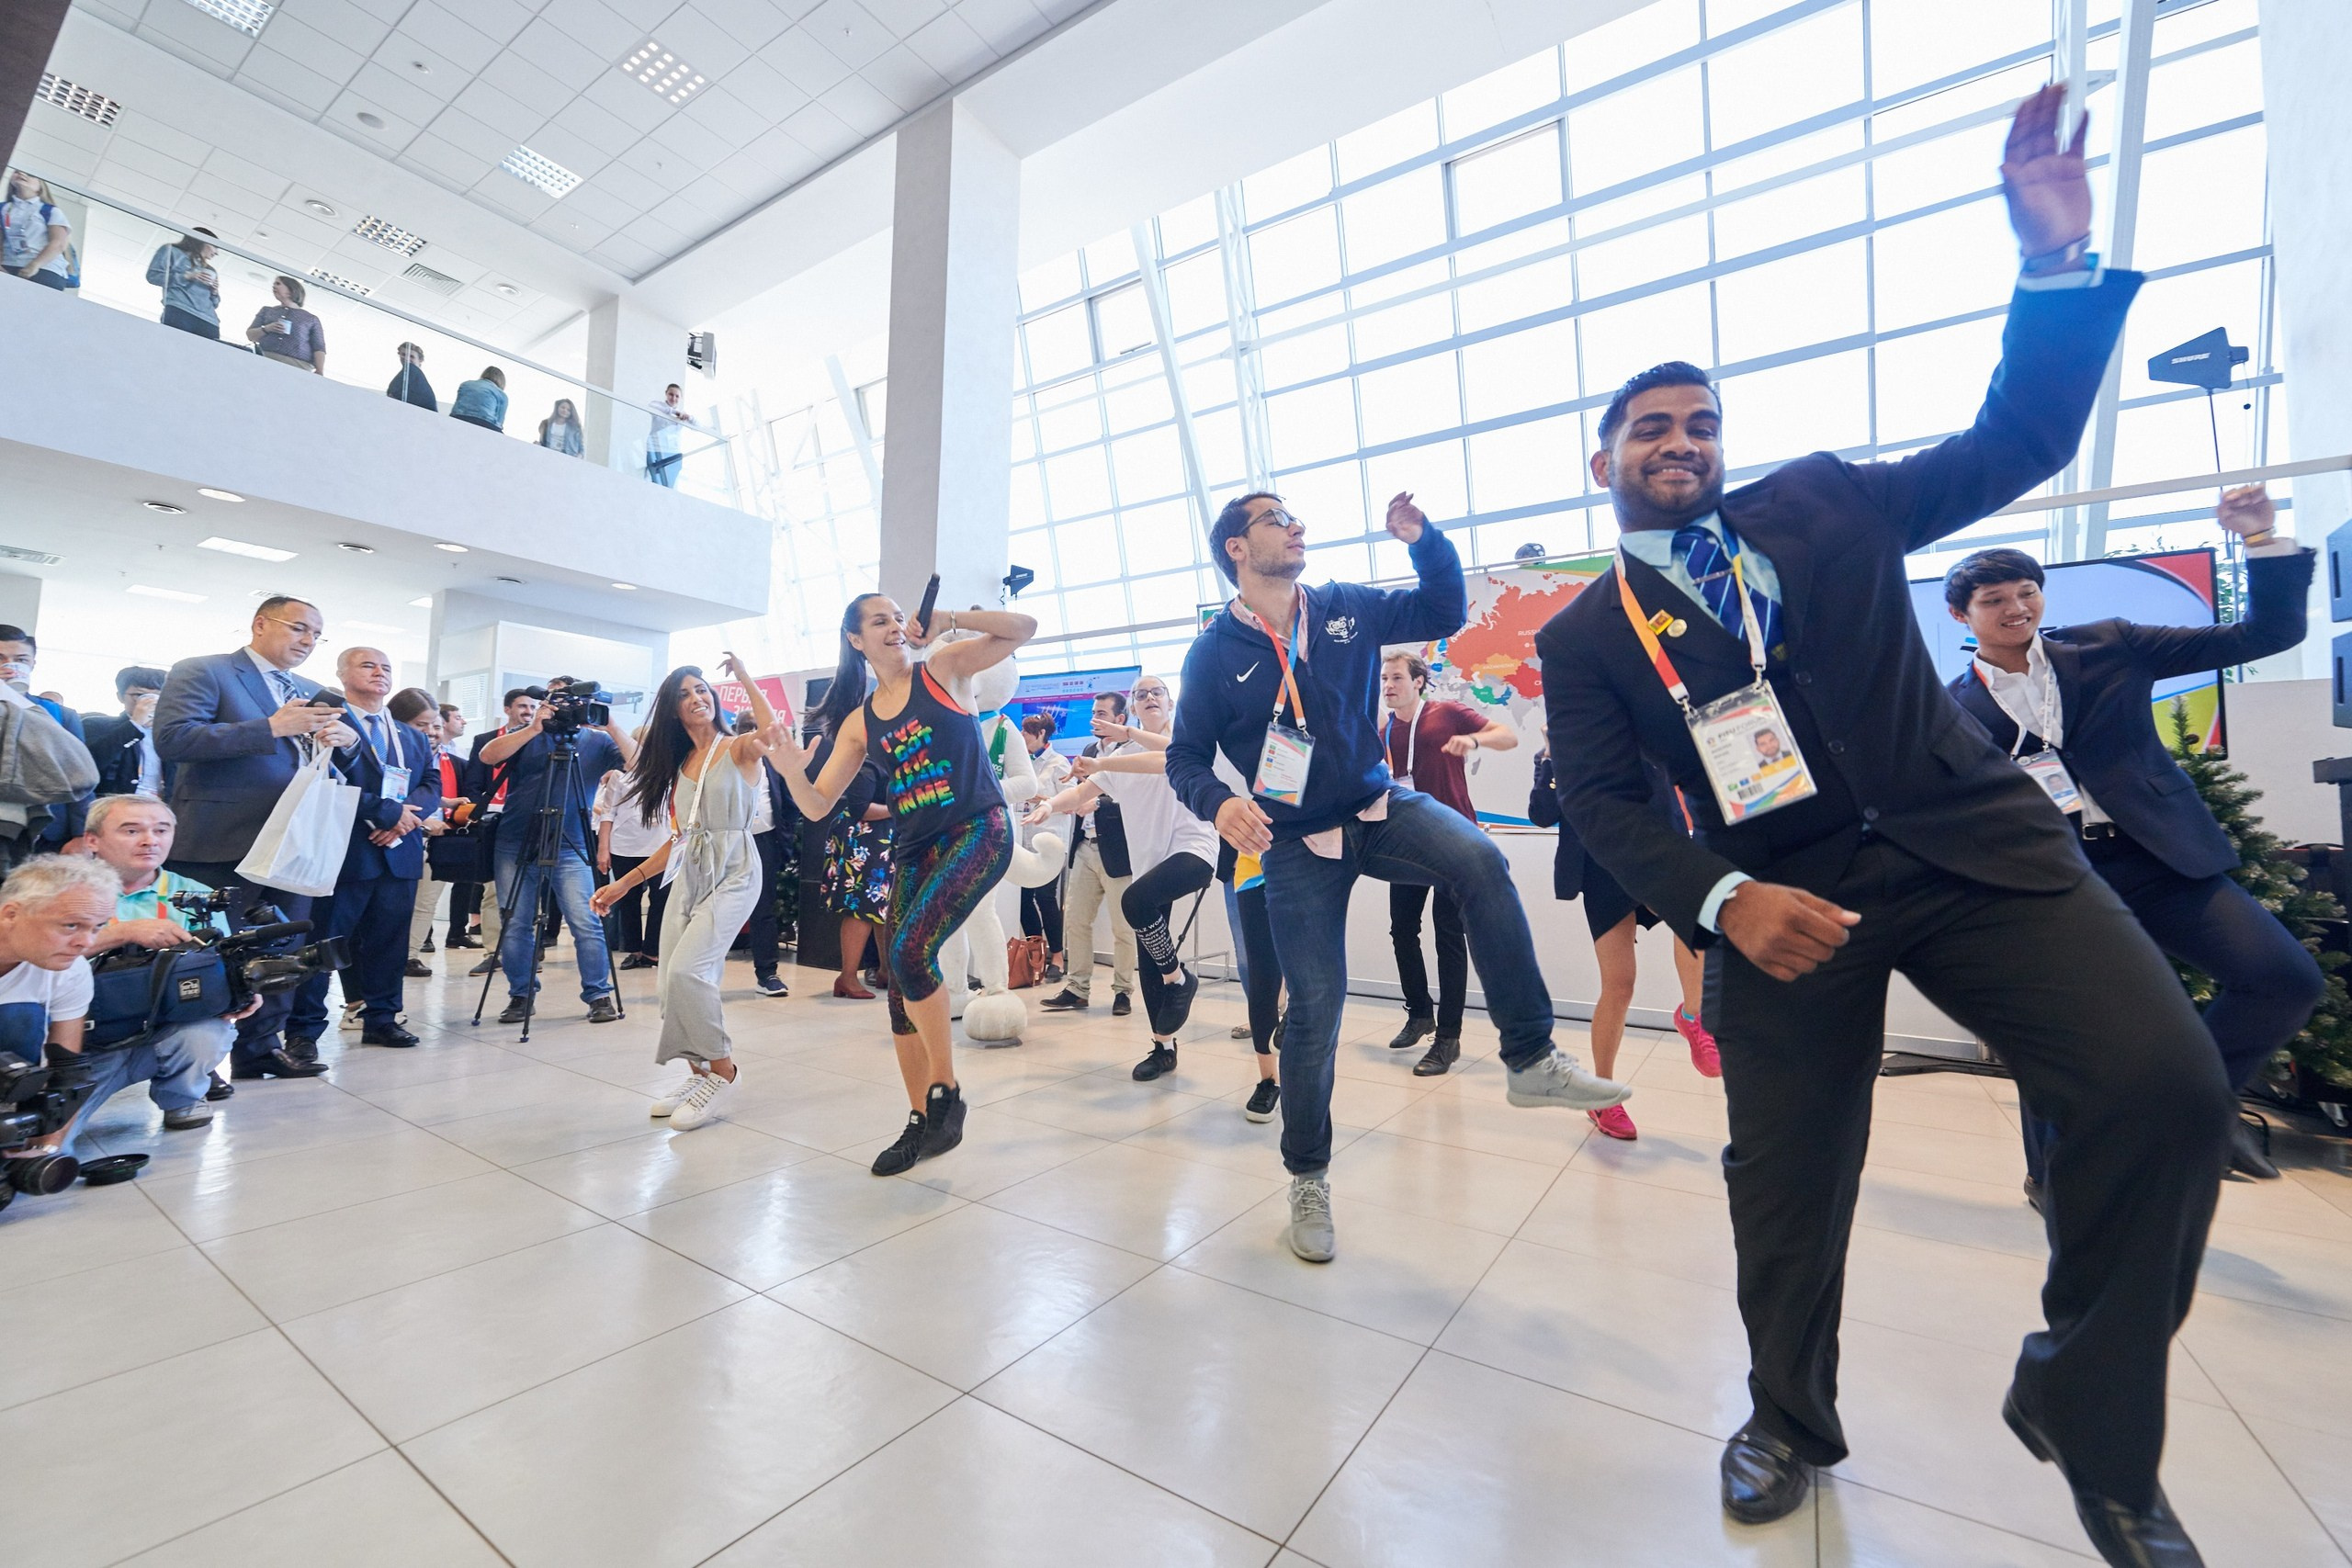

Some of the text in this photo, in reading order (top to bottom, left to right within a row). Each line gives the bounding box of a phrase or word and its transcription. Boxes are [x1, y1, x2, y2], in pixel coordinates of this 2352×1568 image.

[880, 717, 922, 753] I'VE
[894, 726, 933, 762] GOT
[898, 791, 917, 816] IN
[915, 779, 955, 807] ME
